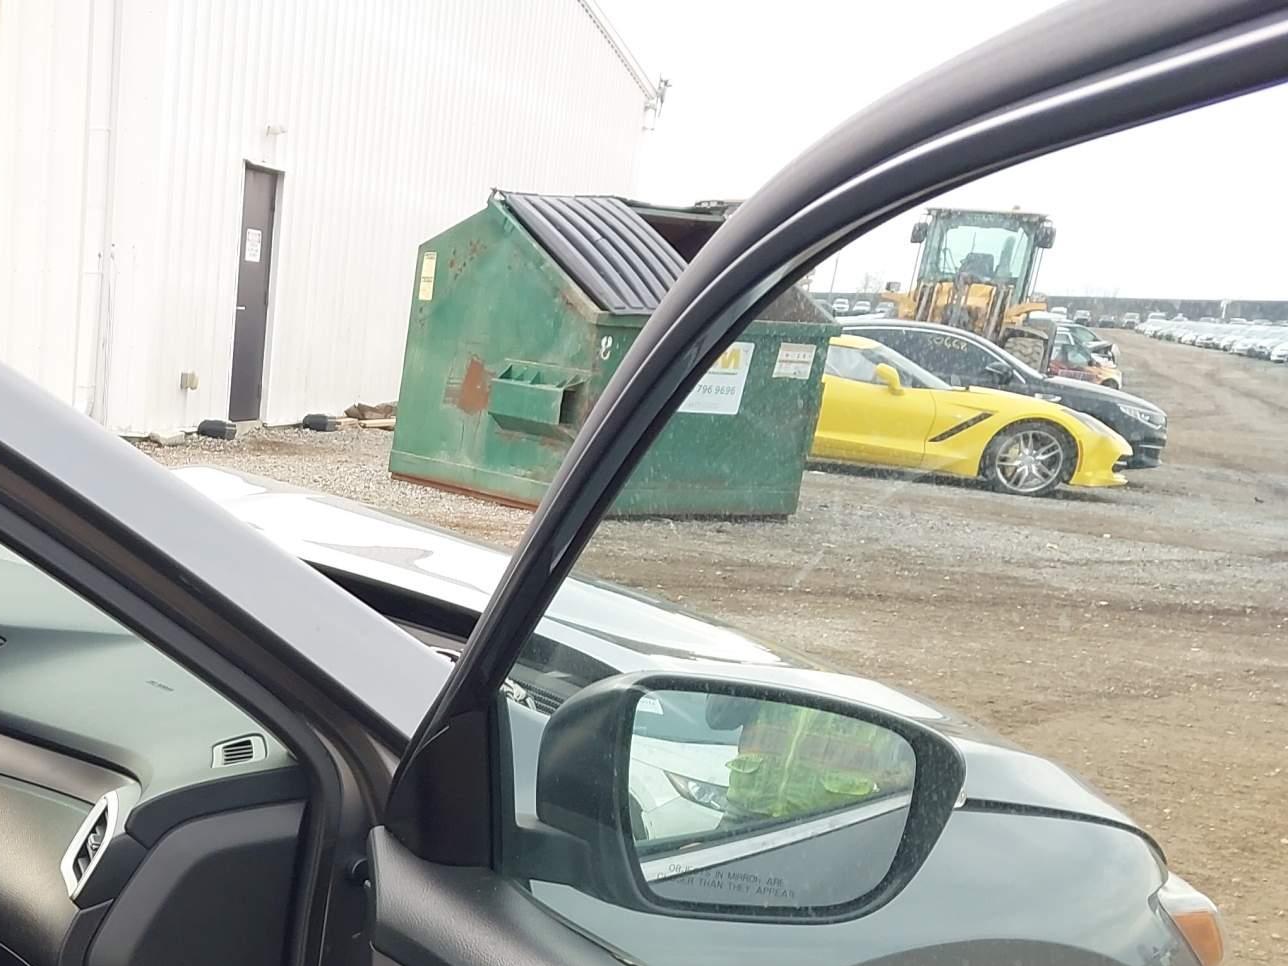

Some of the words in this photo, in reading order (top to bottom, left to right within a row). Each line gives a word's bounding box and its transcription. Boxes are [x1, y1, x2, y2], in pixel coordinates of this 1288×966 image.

[697, 384, 713, 394] 796
[715, 871, 724, 880] IN
[767, 877, 784, 888] ARE
[699, 879, 723, 890] THAN
[728, 883, 750, 893] THEY
[756, 886, 795, 898] APPEAR
